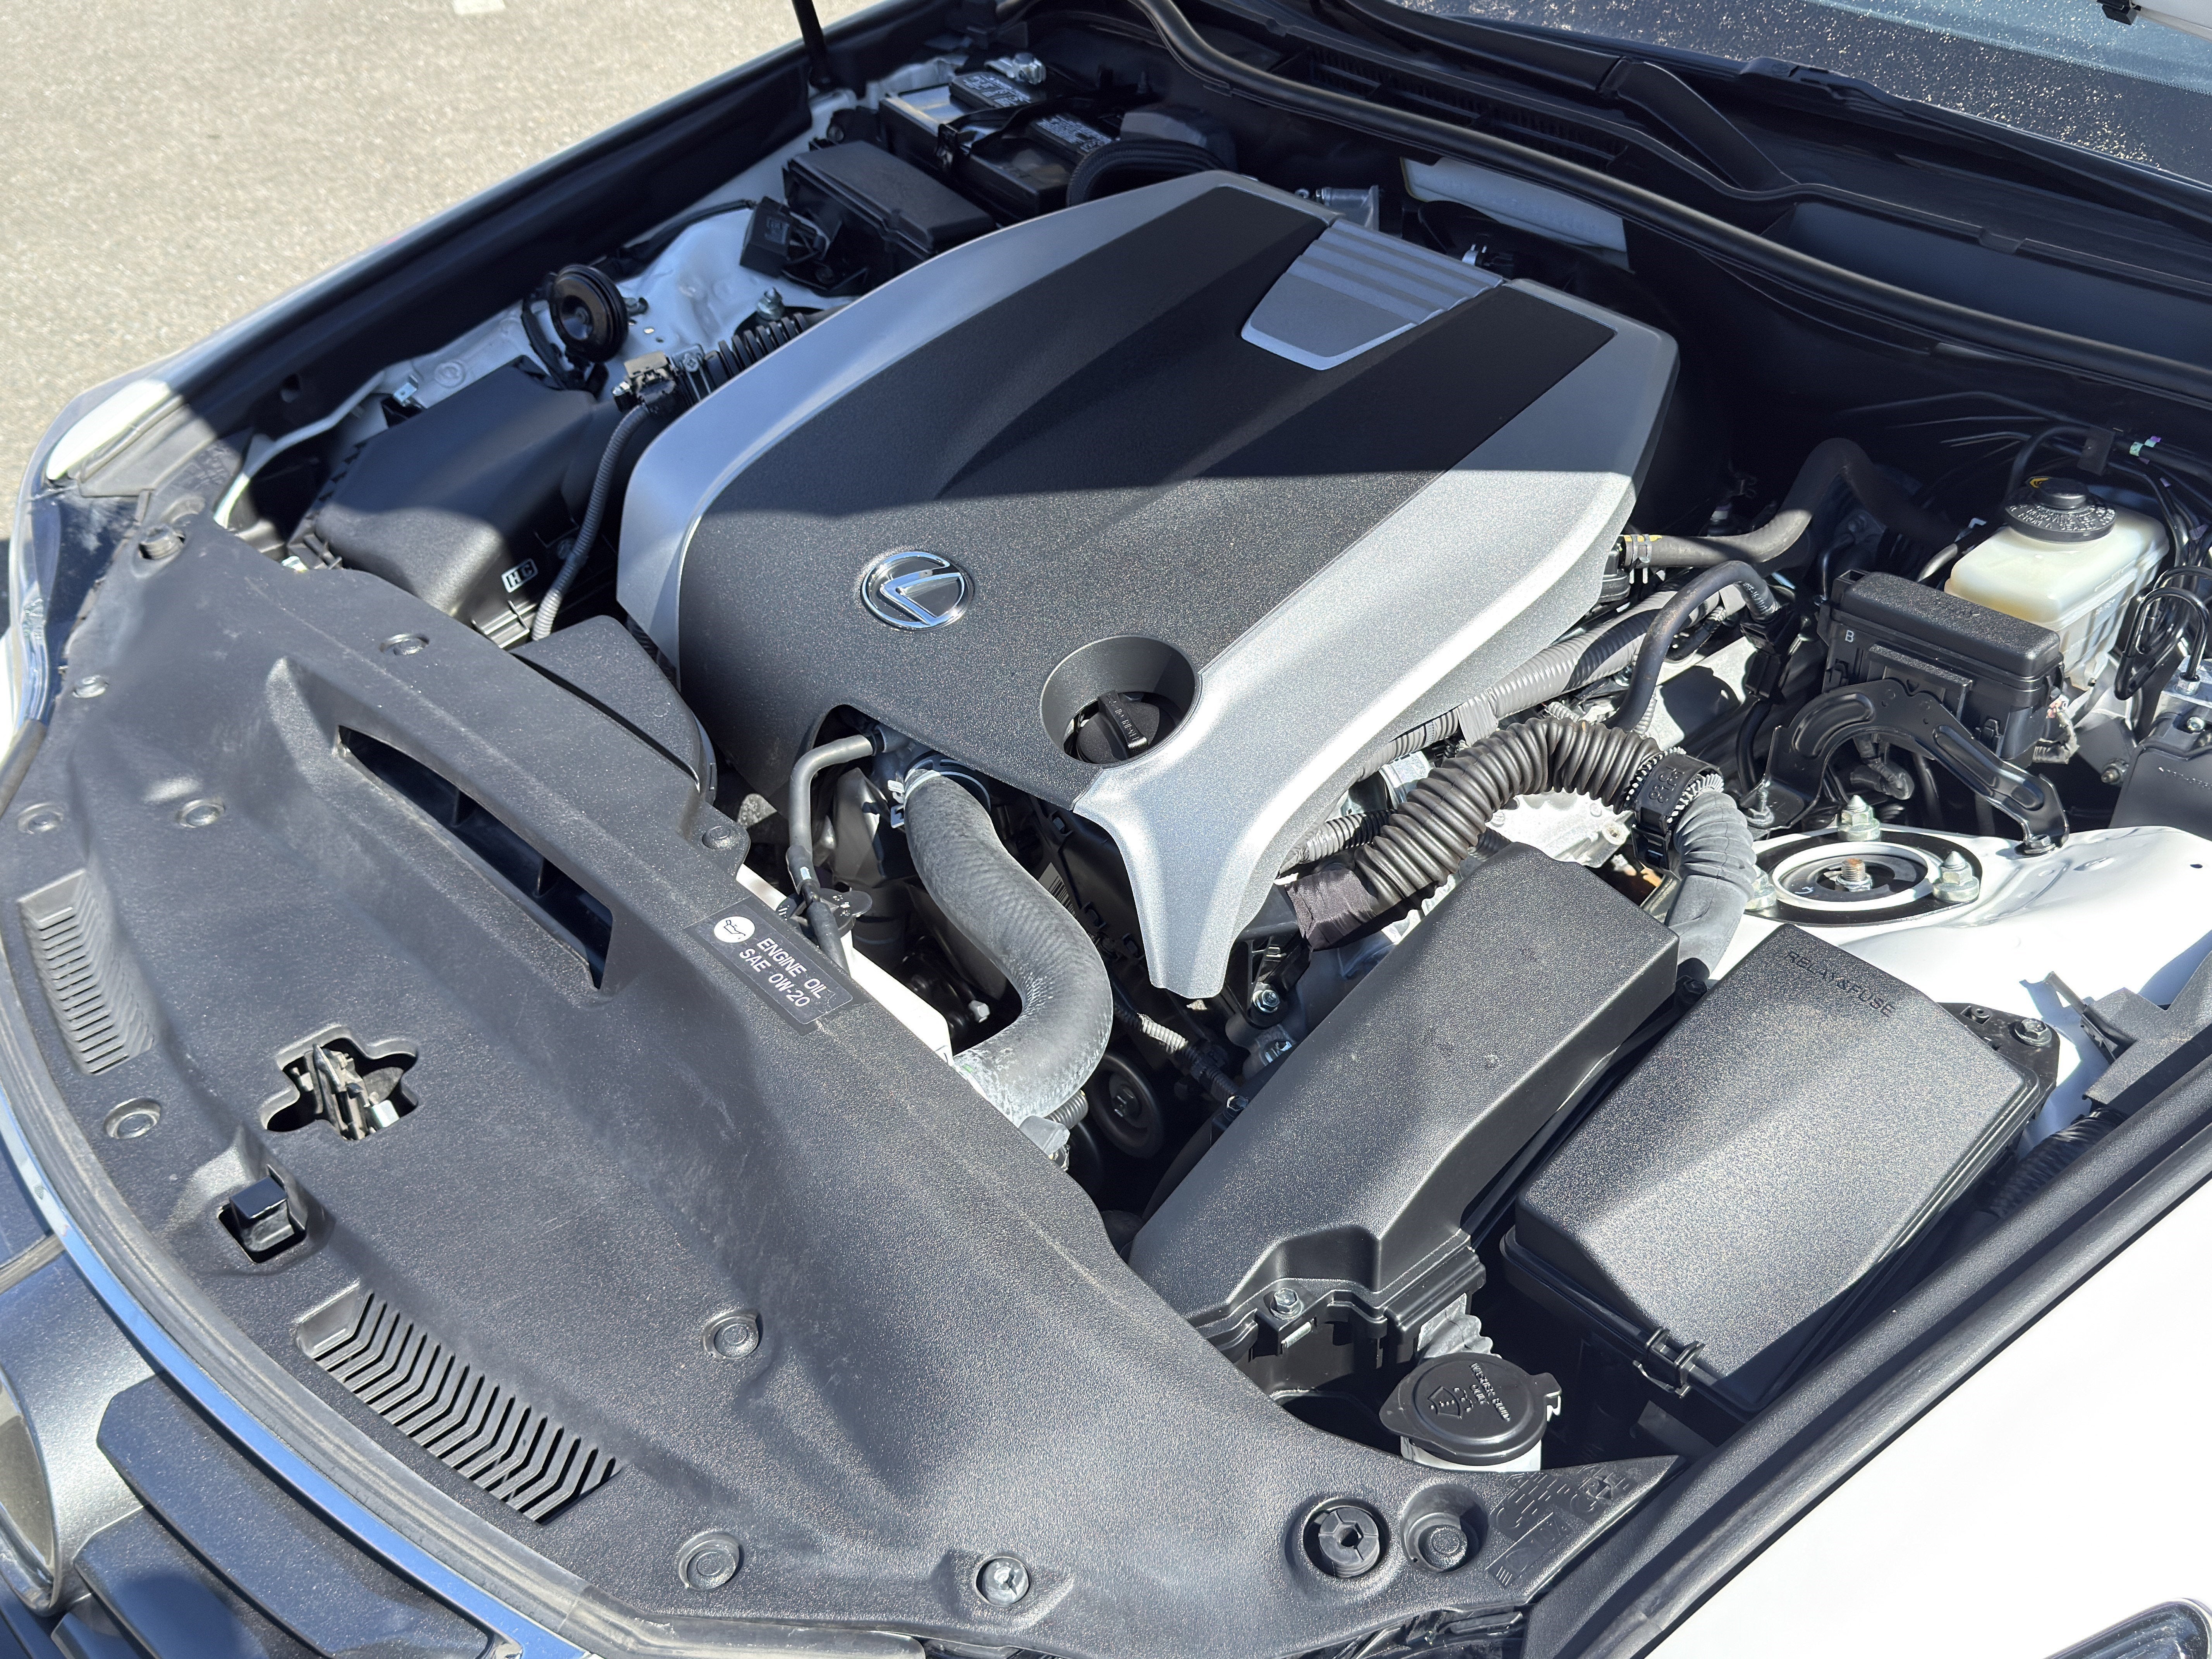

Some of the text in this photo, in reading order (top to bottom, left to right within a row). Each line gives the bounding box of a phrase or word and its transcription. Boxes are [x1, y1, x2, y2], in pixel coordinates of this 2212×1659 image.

[1845, 630, 1854, 642] B
[740, 948, 810, 1007] SAE 0W-20
[757, 937, 828, 999] ENGINE OIL
